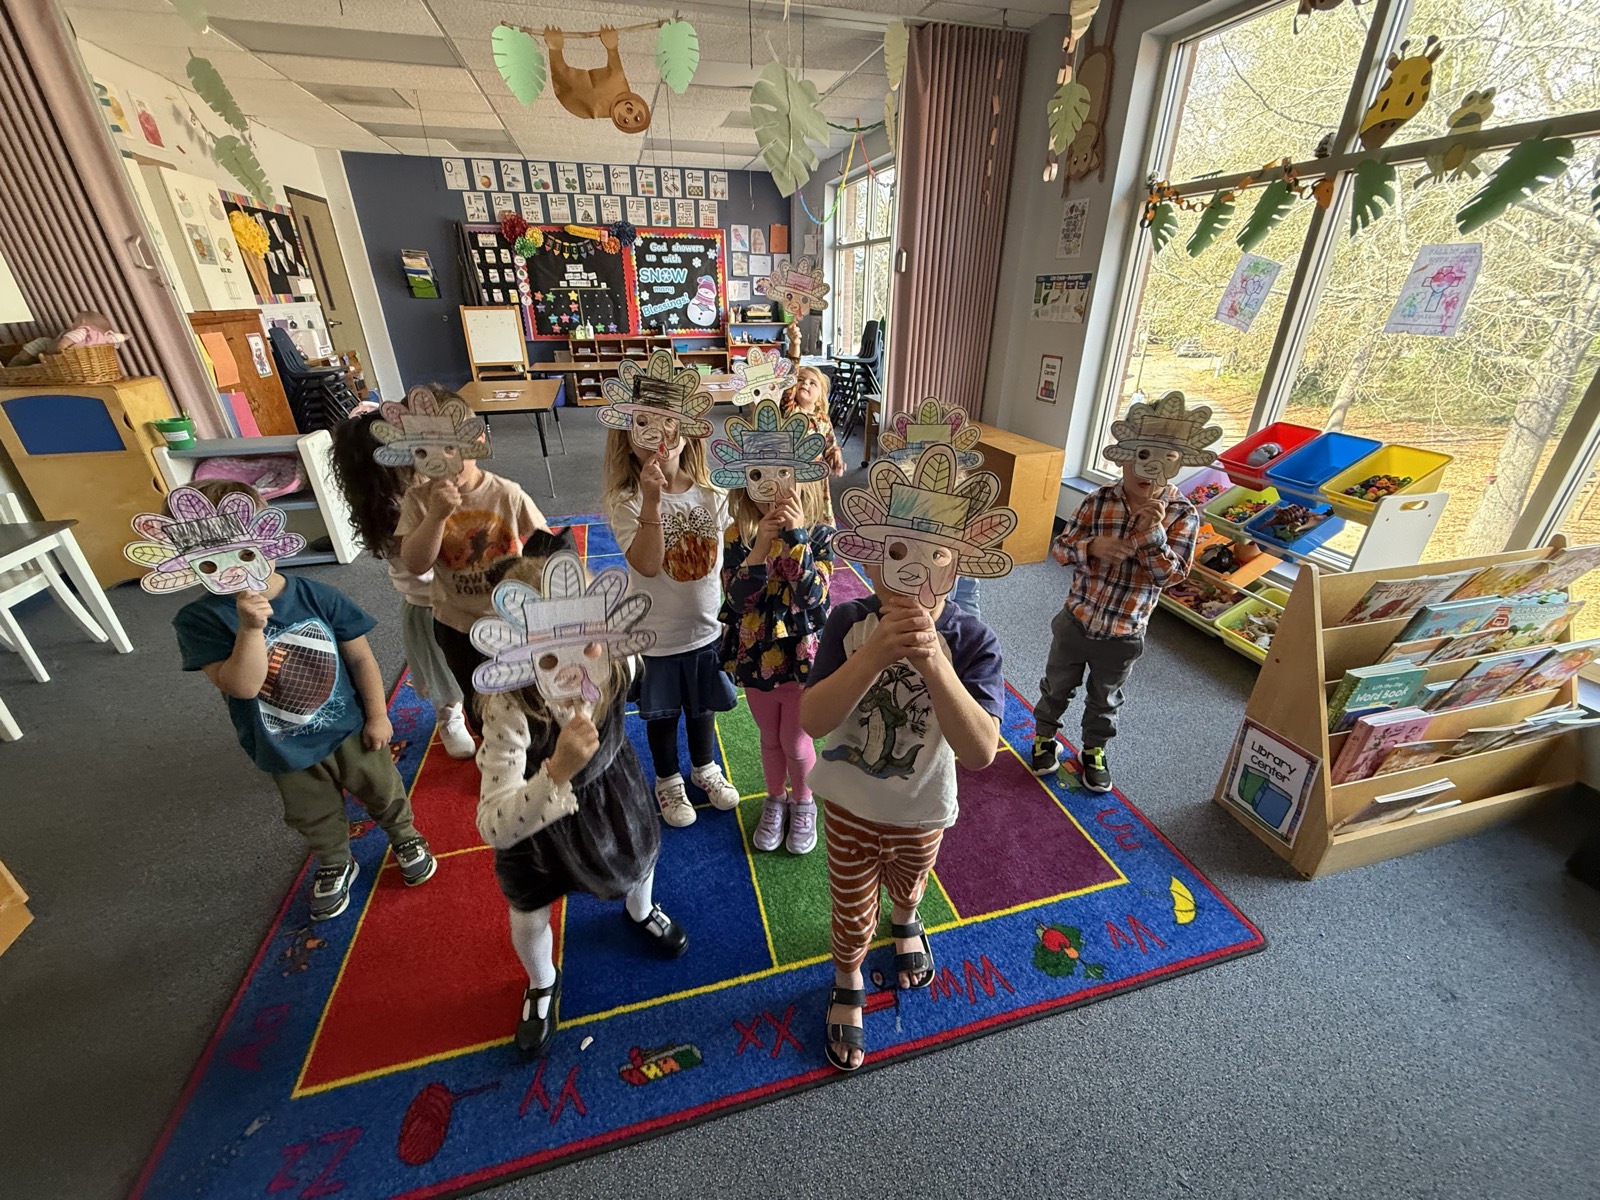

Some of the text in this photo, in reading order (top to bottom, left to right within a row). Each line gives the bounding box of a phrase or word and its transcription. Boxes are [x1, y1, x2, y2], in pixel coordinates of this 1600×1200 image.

[444, 161, 453, 173] 0
[502, 163, 511, 175] 2
[530, 164, 539, 176] 3
[558, 165, 566, 177] 4
[585, 166, 593, 178] 5
[611, 167, 619, 179] 6
[637, 169, 644, 181] 7
[662, 170, 670, 181] 8
[686, 172, 694, 183] 9
[710, 174, 718, 184] 10
[494, 196, 503, 206] 12
[521, 196, 530, 207] 13
[550, 196, 558, 207] 14
[577, 197, 585, 208] 15
[602, 198, 611, 209] 16
[628, 200, 636, 210] 17
[652, 201, 660, 211] 18
[676, 202, 685, 212] 19
[700, 203, 709, 212] 20
[650, 242, 705, 253] God showers
[645, 253, 682, 264] us with
[639, 267, 688, 283] SNOW
[653, 286, 675, 294] many
[642, 292, 690, 317] Blessings!
[1356, 691, 1382, 702] Word
[1250, 741, 1297, 776] Library
[1250, 754, 1291, 783] Center
[1097, 808, 1142, 851] Uu
[733, 1004, 804, 1059] Xx
[519, 1060, 588, 1126] Yy
[267, 1126, 362, 1199] Zz
